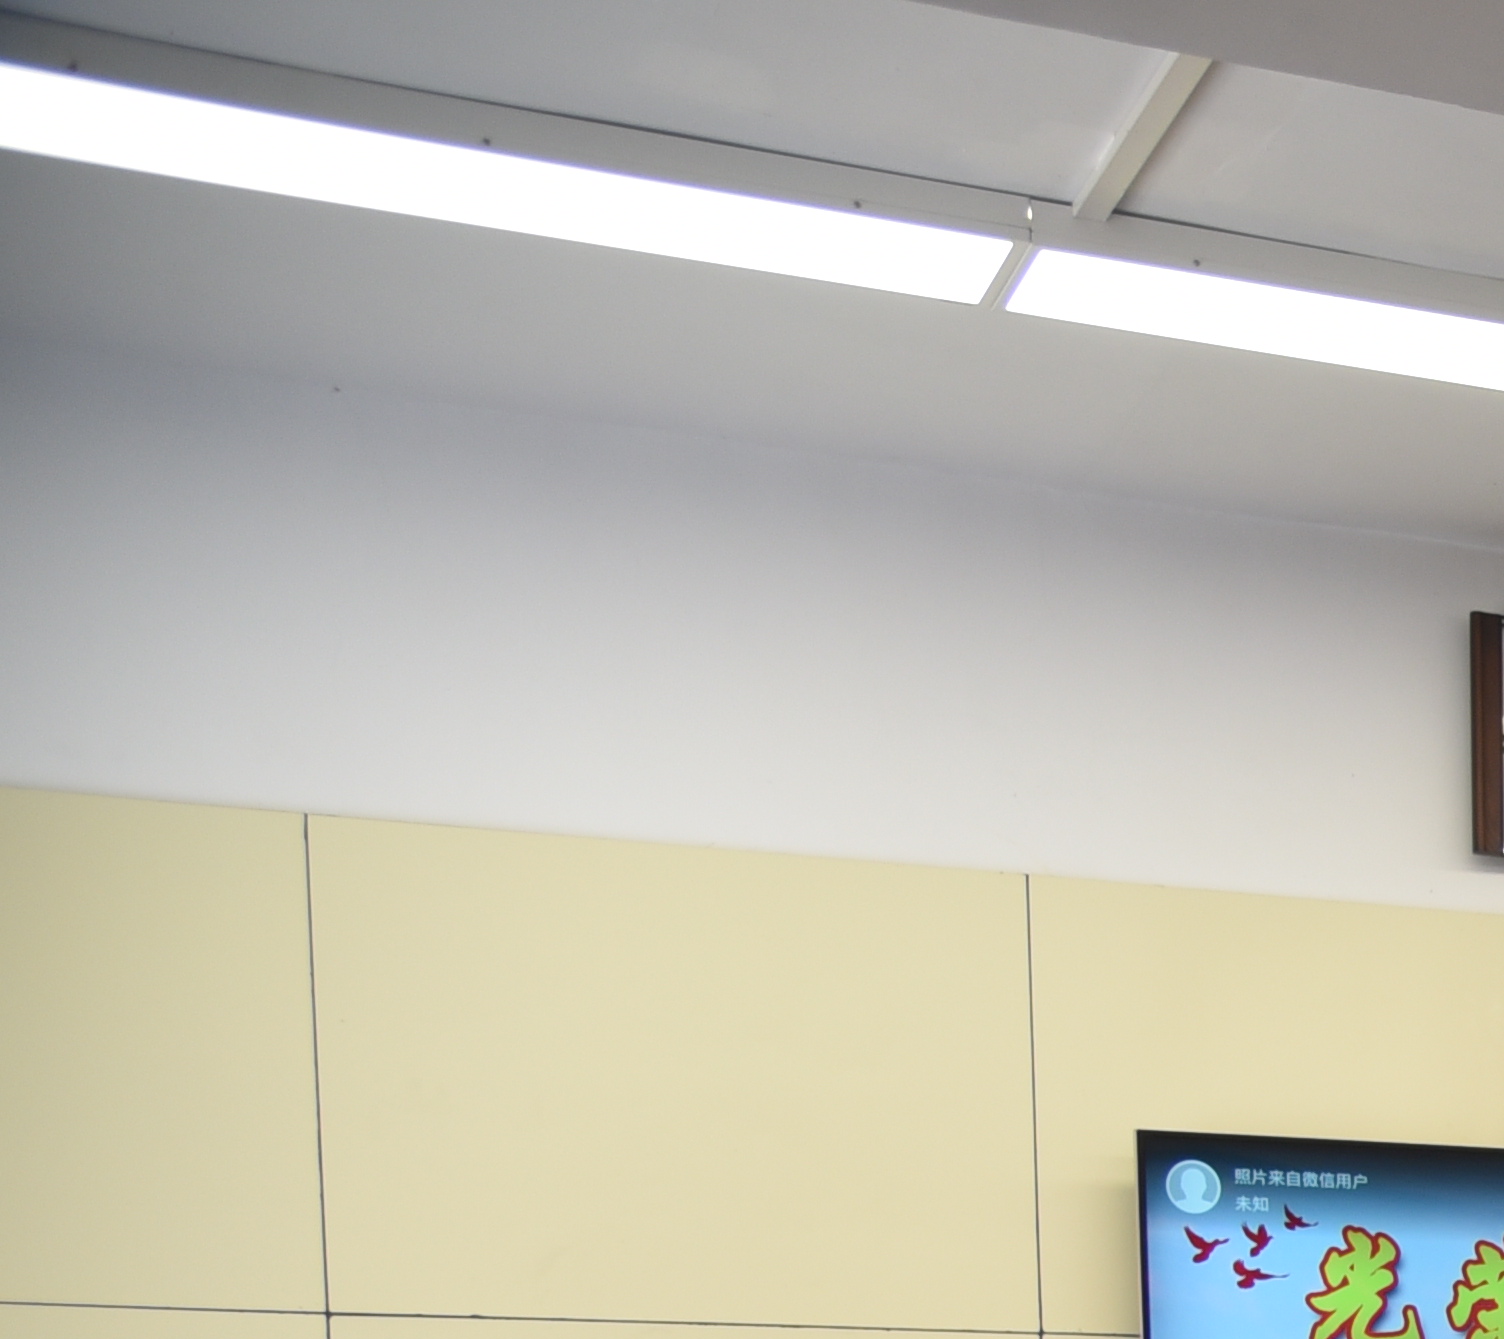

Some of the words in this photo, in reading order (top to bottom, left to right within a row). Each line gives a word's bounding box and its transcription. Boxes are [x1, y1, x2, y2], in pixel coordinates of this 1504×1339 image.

[1234, 1168, 1368, 1190] 照片来自微信用户
[1235, 1196, 1269, 1212] 未知
